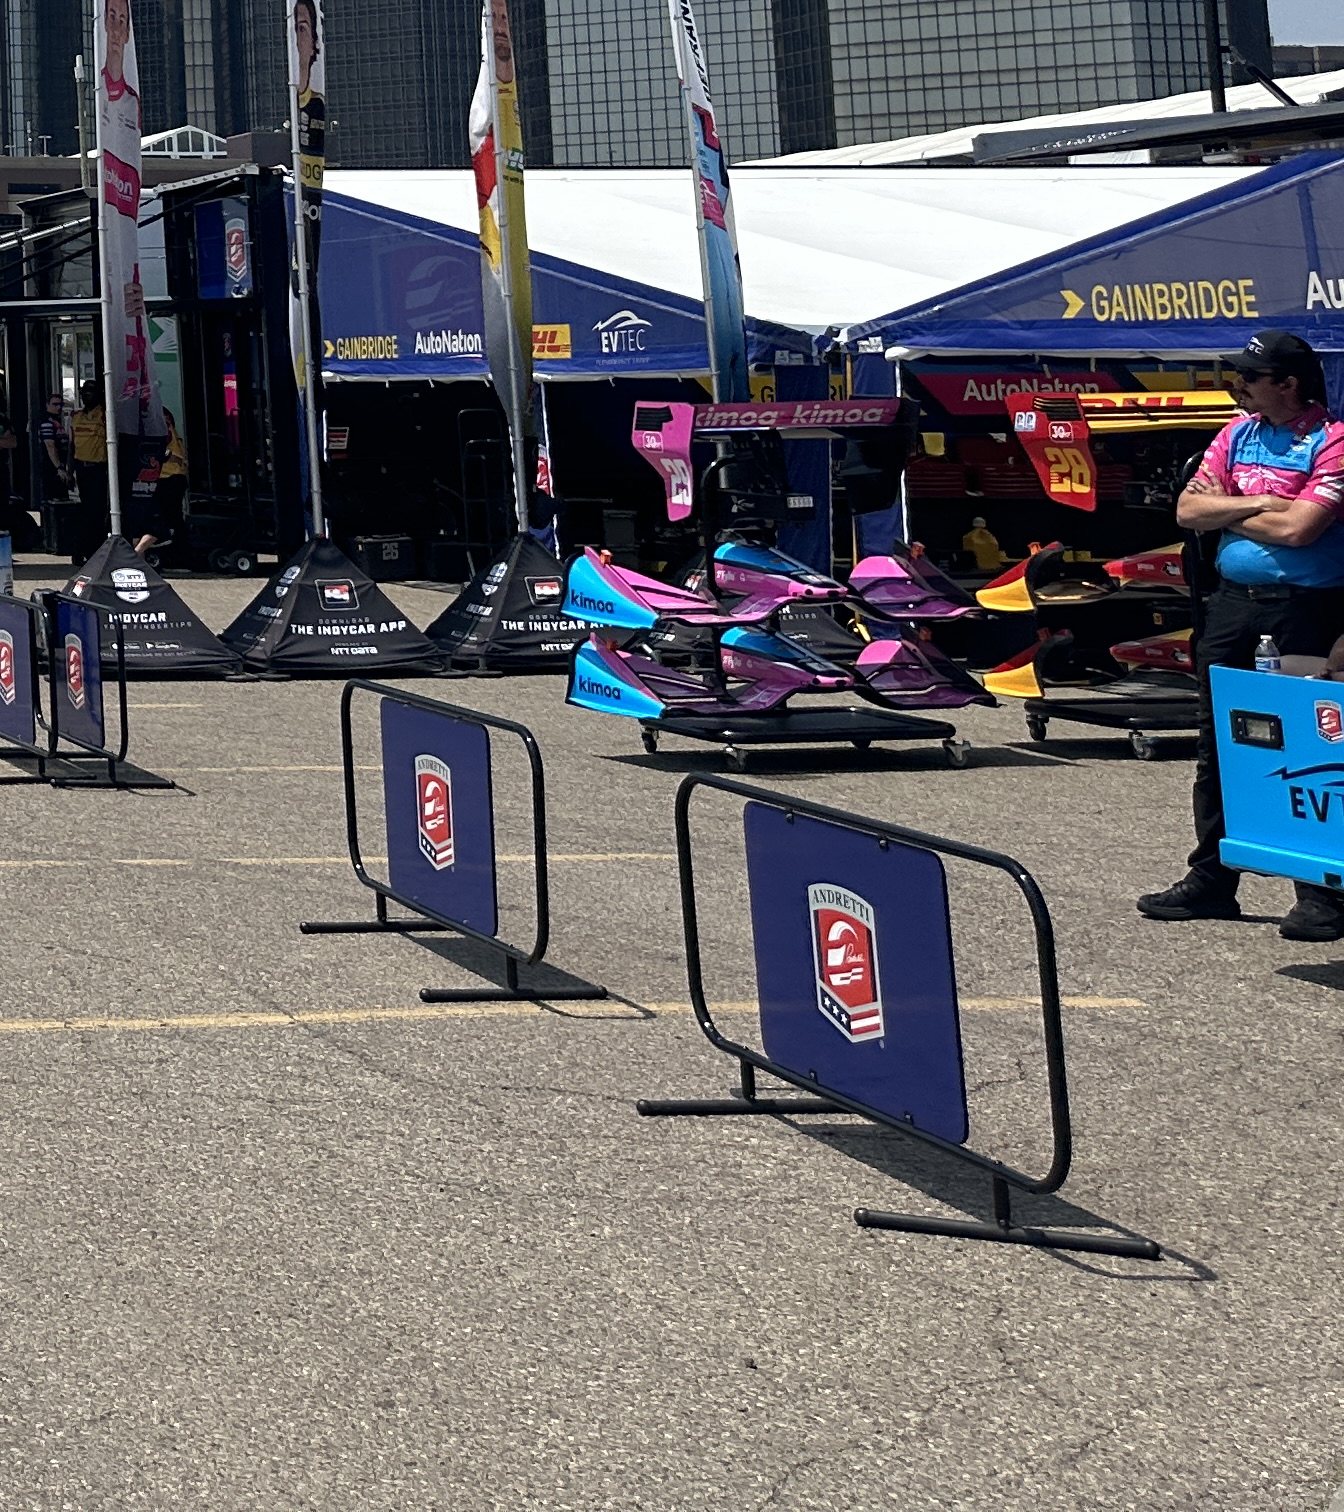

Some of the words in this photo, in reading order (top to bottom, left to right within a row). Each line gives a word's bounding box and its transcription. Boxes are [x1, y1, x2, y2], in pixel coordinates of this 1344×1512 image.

[1091, 278, 1260, 323] GAINBRIDGE
[336, 335, 399, 360] GAINBRIDGE
[414, 328, 483, 355] AutoNation
[532, 330, 561, 353] HL
[601, 328, 646, 353] EVTEC
[791, 403, 883, 425] kimoa
[1044, 446, 1091, 494] 28
[382, 543, 399, 561] 26
[570, 589, 615, 614] kimoa
[291, 624, 314, 635] THE
[317, 623, 376, 635] INDYCAR
[379, 620, 407, 633] APP
[501, 620, 525, 631] THE
[529, 620, 586, 631] INDYCAR
[330, 646, 350, 656] NTT
[578, 675, 621, 700] kimoa
[417, 758, 449, 781] ANDRETTI
[813, 888, 871, 923] ANDRETTI
